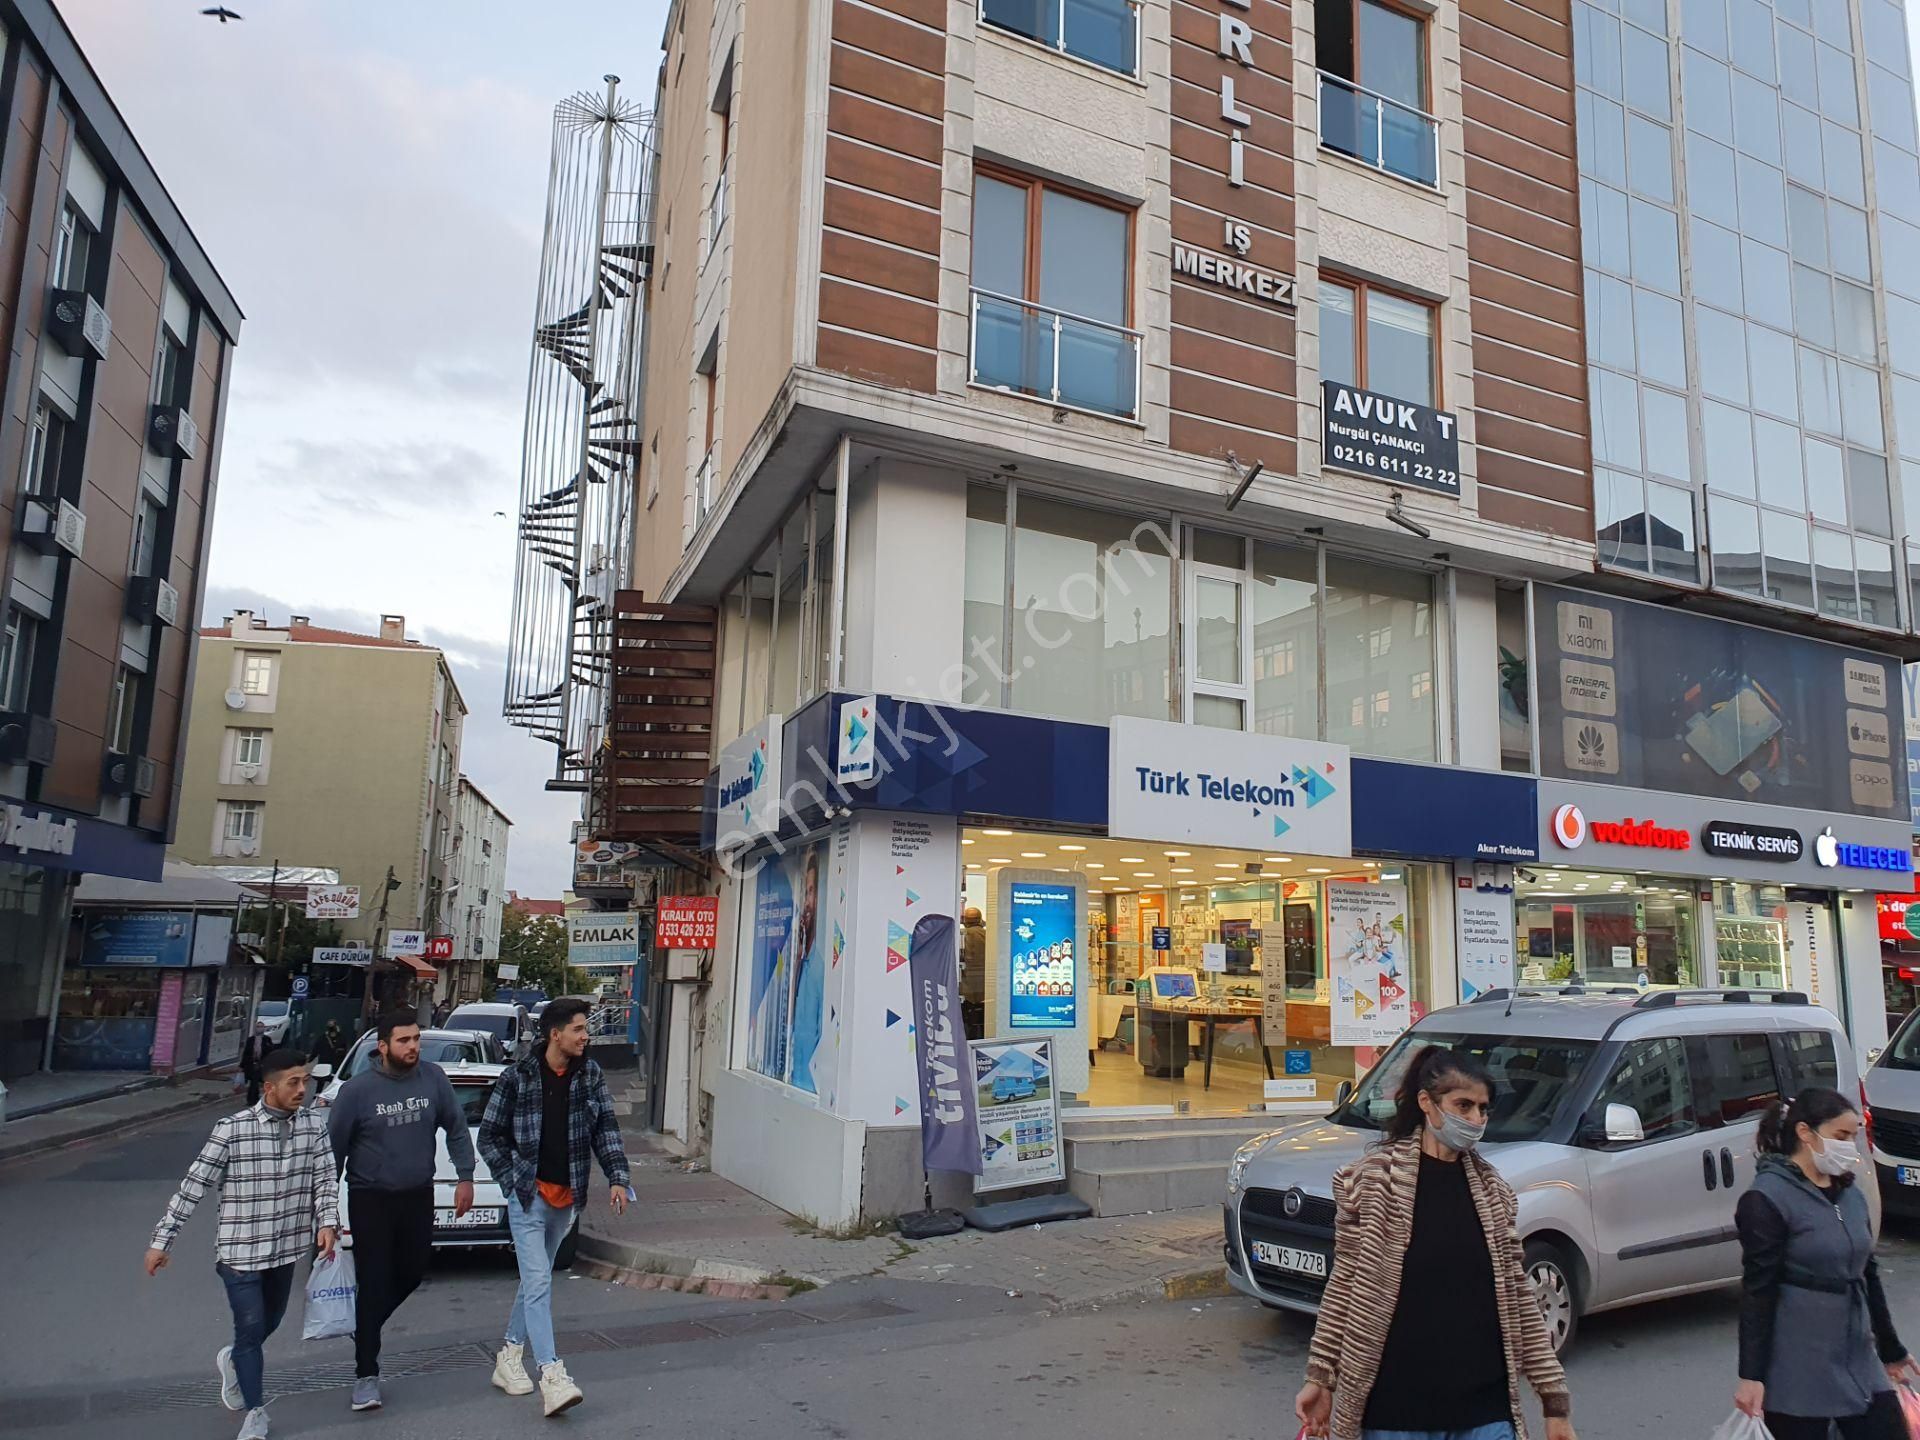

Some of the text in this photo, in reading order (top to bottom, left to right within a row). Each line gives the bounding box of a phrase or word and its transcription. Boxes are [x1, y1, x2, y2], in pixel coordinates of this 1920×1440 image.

[1218, 0, 1254, 187] RLİ
[1329, 421, 1425, 455] Nurgül ÇANAKÇI
[1333, 445, 1457, 486] 0216 611 22 22
[1566, 632, 1607, 652] xiaomi
[1565, 675, 1611, 690] GENERAL
[1849, 670, 1881, 685] SAMSUNG
[1861, 728, 1887, 744] iPhone
[1577, 756, 1606, 768] HUAWEI
[1135, 766, 1295, 807] Türk Telekom
[1590, 817, 1691, 850] vodafone
[1477, 843, 1535, 857] Aker Telekom
[1711, 831, 1799, 854] TEKNİK SERVİS
[1837, 843, 1915, 872] TELECELL
[309, 893, 331, 909] CAFE
[697, 910, 715, 922] OTO
[572, 927, 635, 943] EMLAK
[658, 923, 715, 937] 0 533 426 29 25
[403, 934, 420, 944] AVM
[319, 950, 370, 962] CAFE DÜRÜM
[1805, 905, 1820, 1004] Faturamatik
[1381, 986, 1398, 997] 100
[1357, 999, 1367, 1008] 50
[924, 979, 935, 1069] Telekom
[976, 1058, 993, 1066] Mobil
[376, 1096, 430, 1116] Road Trip
[1905, 1168, 1918, 1181] 34
[433, 1210, 440, 1224] 4
[468, 1210, 497, 1223] 3554
[1260, 1243, 1323, 1273] 34 VS 7278
